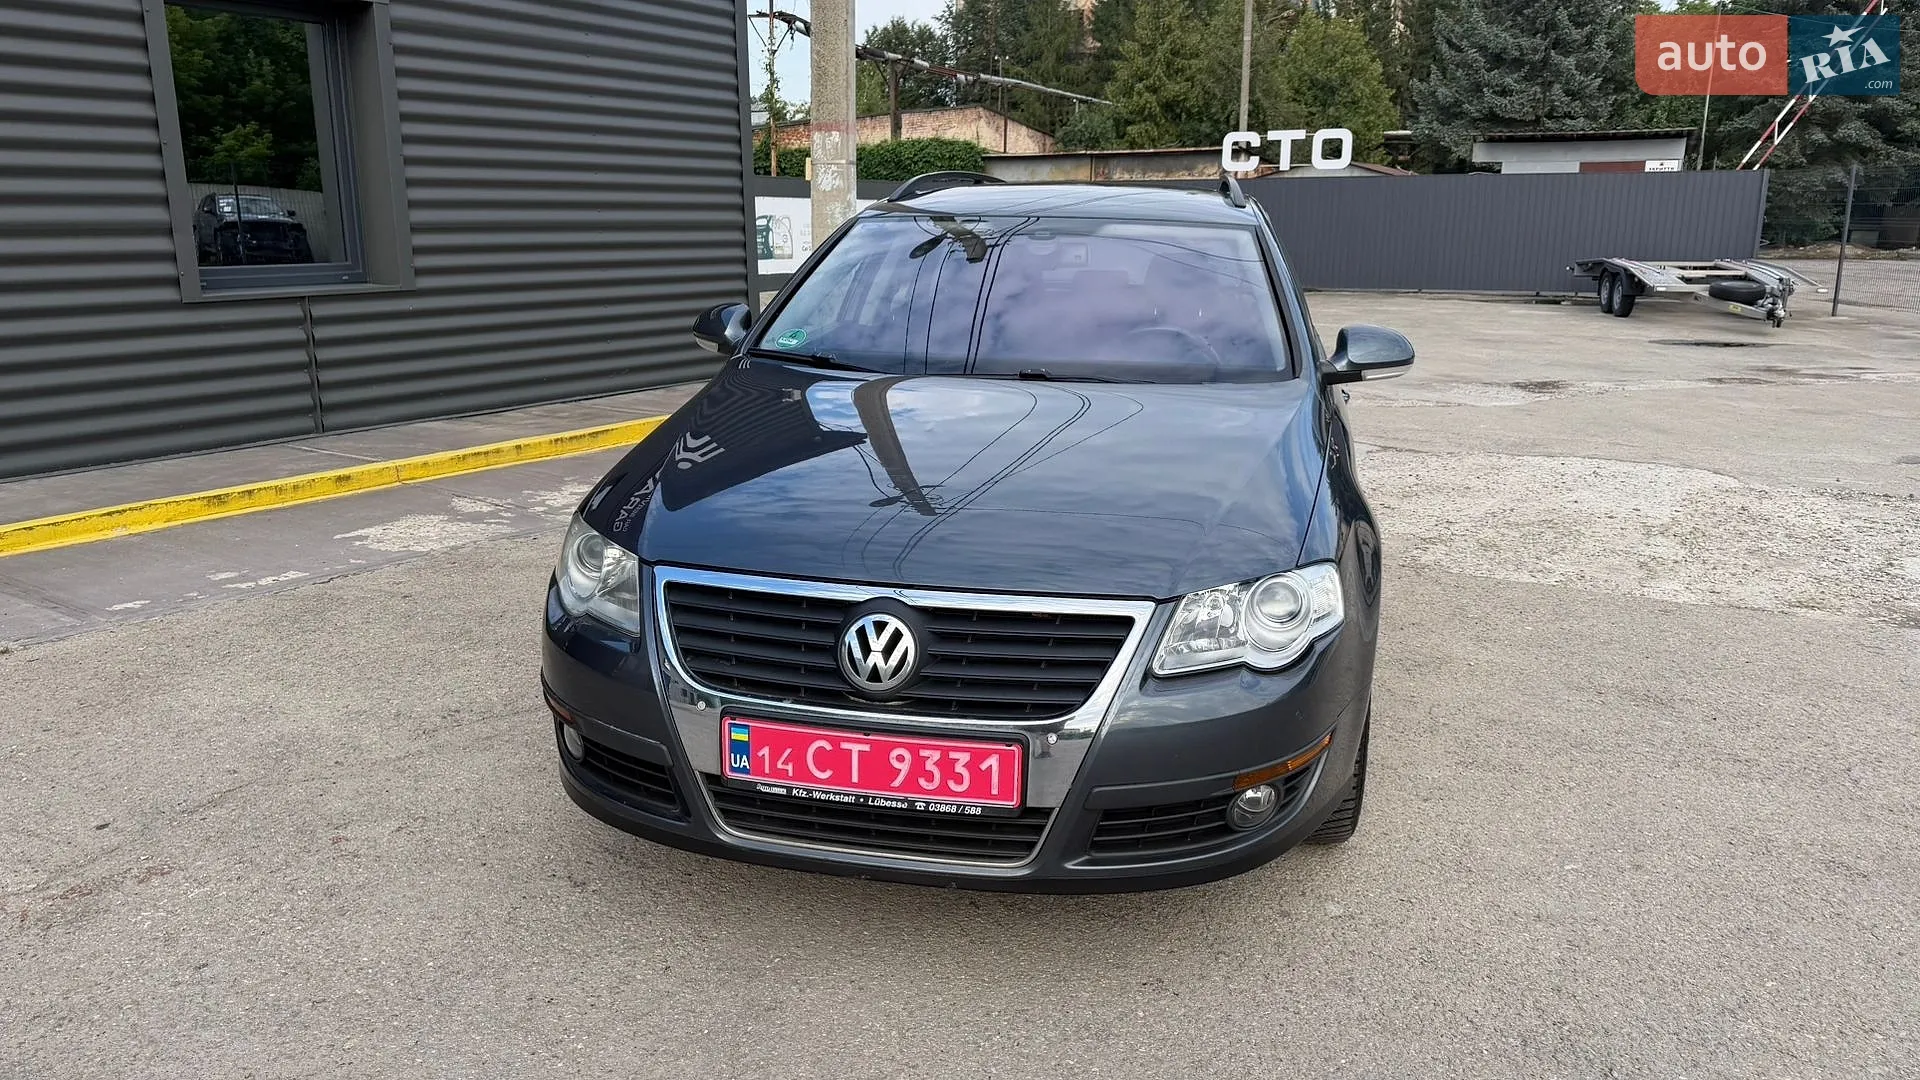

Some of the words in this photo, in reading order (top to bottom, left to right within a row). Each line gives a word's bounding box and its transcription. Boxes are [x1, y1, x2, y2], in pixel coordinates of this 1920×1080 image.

[1221, 128, 1354, 172] СТО
[731, 753, 750, 769] UA
[756, 745, 793, 777] 14
[806, 739, 871, 783] CT
[888, 747, 999, 796] 9331
[791, 787, 856, 804] Kfz.-Werkstatt
[928, 803, 957, 814] 03868
[964, 806, 983, 815] 588
